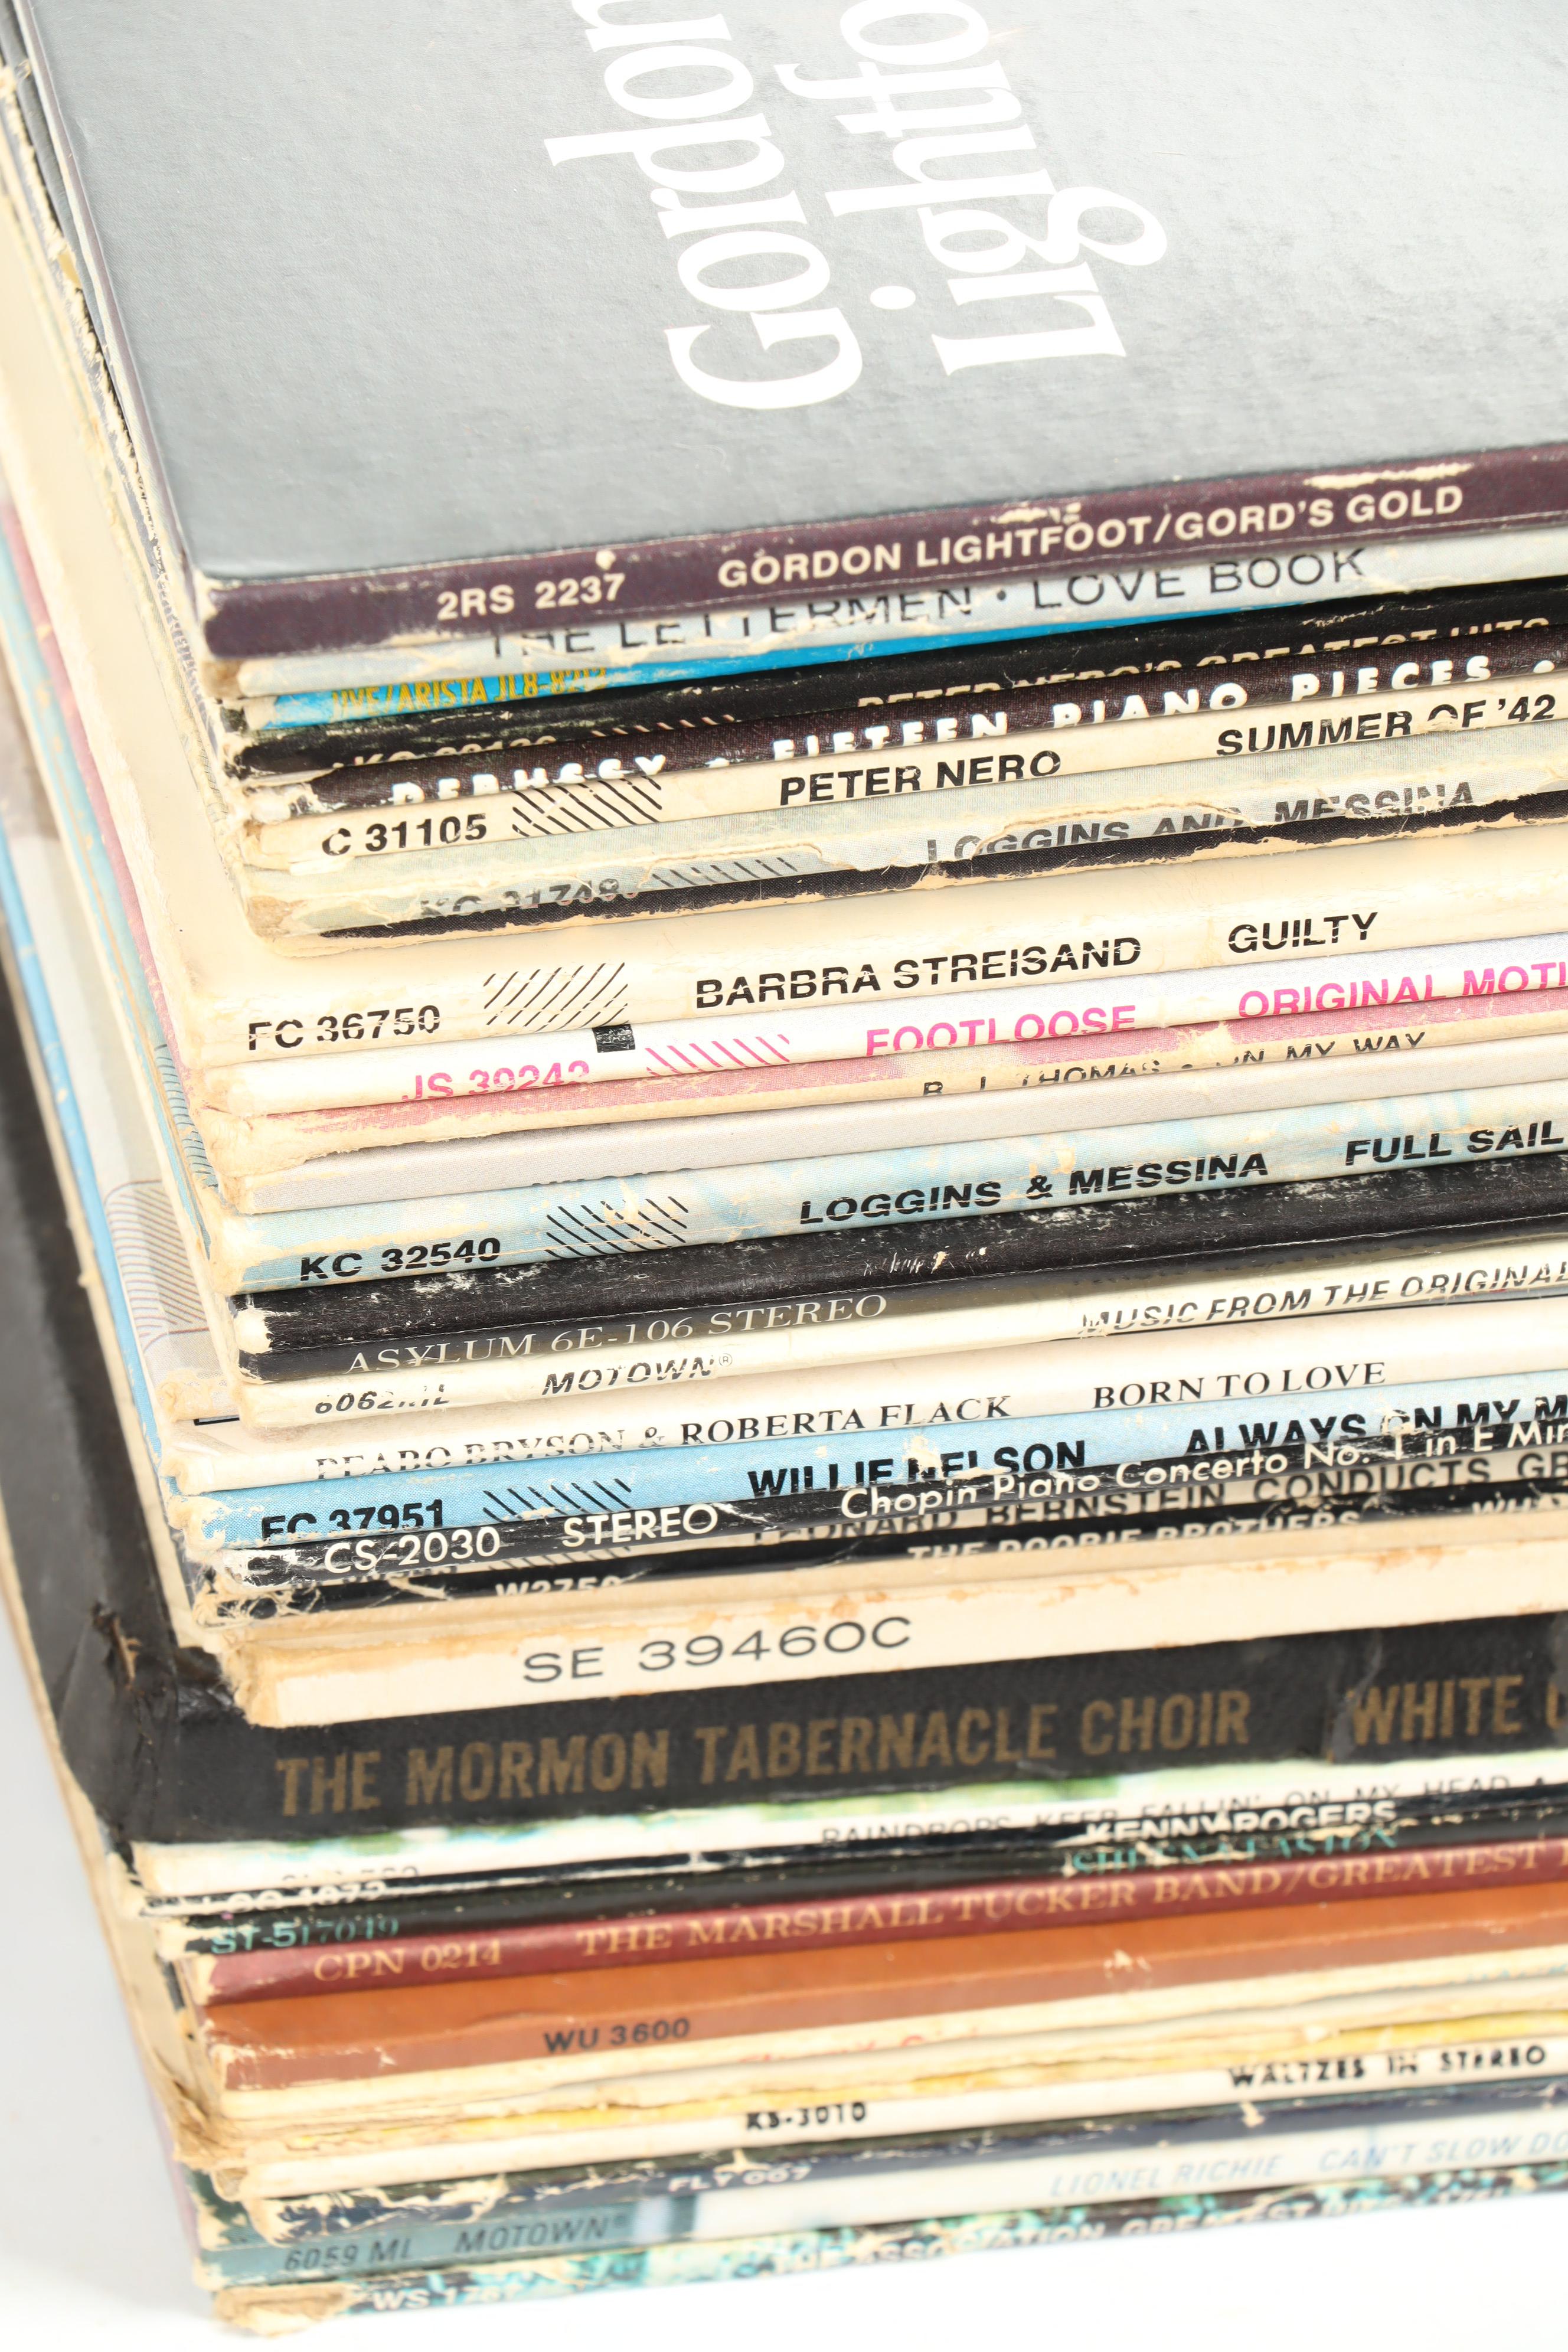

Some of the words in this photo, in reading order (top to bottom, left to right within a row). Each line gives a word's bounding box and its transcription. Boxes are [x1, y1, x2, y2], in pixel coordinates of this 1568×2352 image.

[436, 584, 516, 622] 2RS
[534, 571, 626, 609] 2237
[717, 541, 901, 589] GORDON
[916, 497, 1335, 569] LIGHTFOOT/GORD'S
[1345, 485, 1464, 523] GOLD
[1034, 570, 1185, 609] LOVE
[1209, 547, 1366, 593] BOOK
[1291, 655, 1492, 702] PIECES
[321, 827, 352, 856] C
[365, 814, 488, 853] 31105
[779, 765, 920, 806] PETER
[937, 750, 1061, 789] NERO
[1217, 710, 1413, 756] SUMMER
[1499, 694, 1556, 721] '42
[248, 1018, 304, 1051] FC
[315, 1004, 441, 1044] 36750
[696, 963, 881, 1008] BARBRA
[893, 937, 1142, 989] STREISAND
[1228, 912, 1378, 953] GUILTY
[401, 1072, 453, 1101] JS
[866, 1005, 1137, 1056] FOOTLOOSE
[1239, 975, 1446, 1018] ORIGINAL
[1353, 1031, 1426, 1051] WAY
[300, 1252, 362, 1281] KC
[381, 1237, 501, 1272] 32540
[800, 1179, 1002, 1224] LOGGINS
[1026, 1174, 1052, 1200] &
[1068, 1151, 1268, 1197] MESSINA
[1345, 1132, 1453, 1166] FULL
[1466, 1119, 1564, 1154] SAIL
[346, 1334, 534, 1373] ASYLUM
[550, 1317, 694, 1351] 6E-106
[708, 1294, 887, 1339] STEREO
[1205, 1287, 1312, 1324] FROM
[1323, 1279, 1390, 1305] THE
[680, 1408, 865, 1446] ROBERTA
[880, 1394, 1011, 1427] FLACK
[1092, 1376, 1206, 1410] BORN
[1216, 1371, 1272, 1397] TO
[1279, 1361, 1387, 1393] LOVE
[1456, 1399, 1520, 1426] MY
[323, 1526, 501, 1574] CS-2030
[561, 1503, 719, 1548] STEREO
[841, 1479, 978, 1518] Chopin
[993, 1472, 1099, 1501] Piano
[1115, 1448, 1288, 1490] Concerto
[1305, 1442, 1370, 1469] No.
[1425, 1433, 1456, 1457] in
[1474, 1426, 1494, 1452] E
[1253, 1457, 1491, 1503] CONDUCTS
[523, 1647, 604, 1683] SE
[275, 1749, 383, 1817] THE
[405, 1729, 671, 1805] MORMON
[695, 1701, 1057, 1785] TABERNACLE
[1080, 1688, 1251, 1756] CHOIR
[1354, 1675, 1524, 1746] WHITE
[313, 1949, 406, 1981] CPN
[421, 1939, 502, 1972] 0214
[576, 1920, 672, 1956] THE
[687, 1898, 945, 1947] MARSHALL
[953, 1879, 1137, 1922] TUCKER
[544, 2028, 600, 2053] WU
[611, 2018, 691, 2046] 3600
[284, 2246, 356, 2272] 6059
[1049, 2167, 1161, 2197] LIONEL
[1178, 2154, 1283, 2184] RICHIE
[1318, 2144, 1416, 2172] CAN'T
[1426, 2137, 1521, 2161] SLOW
